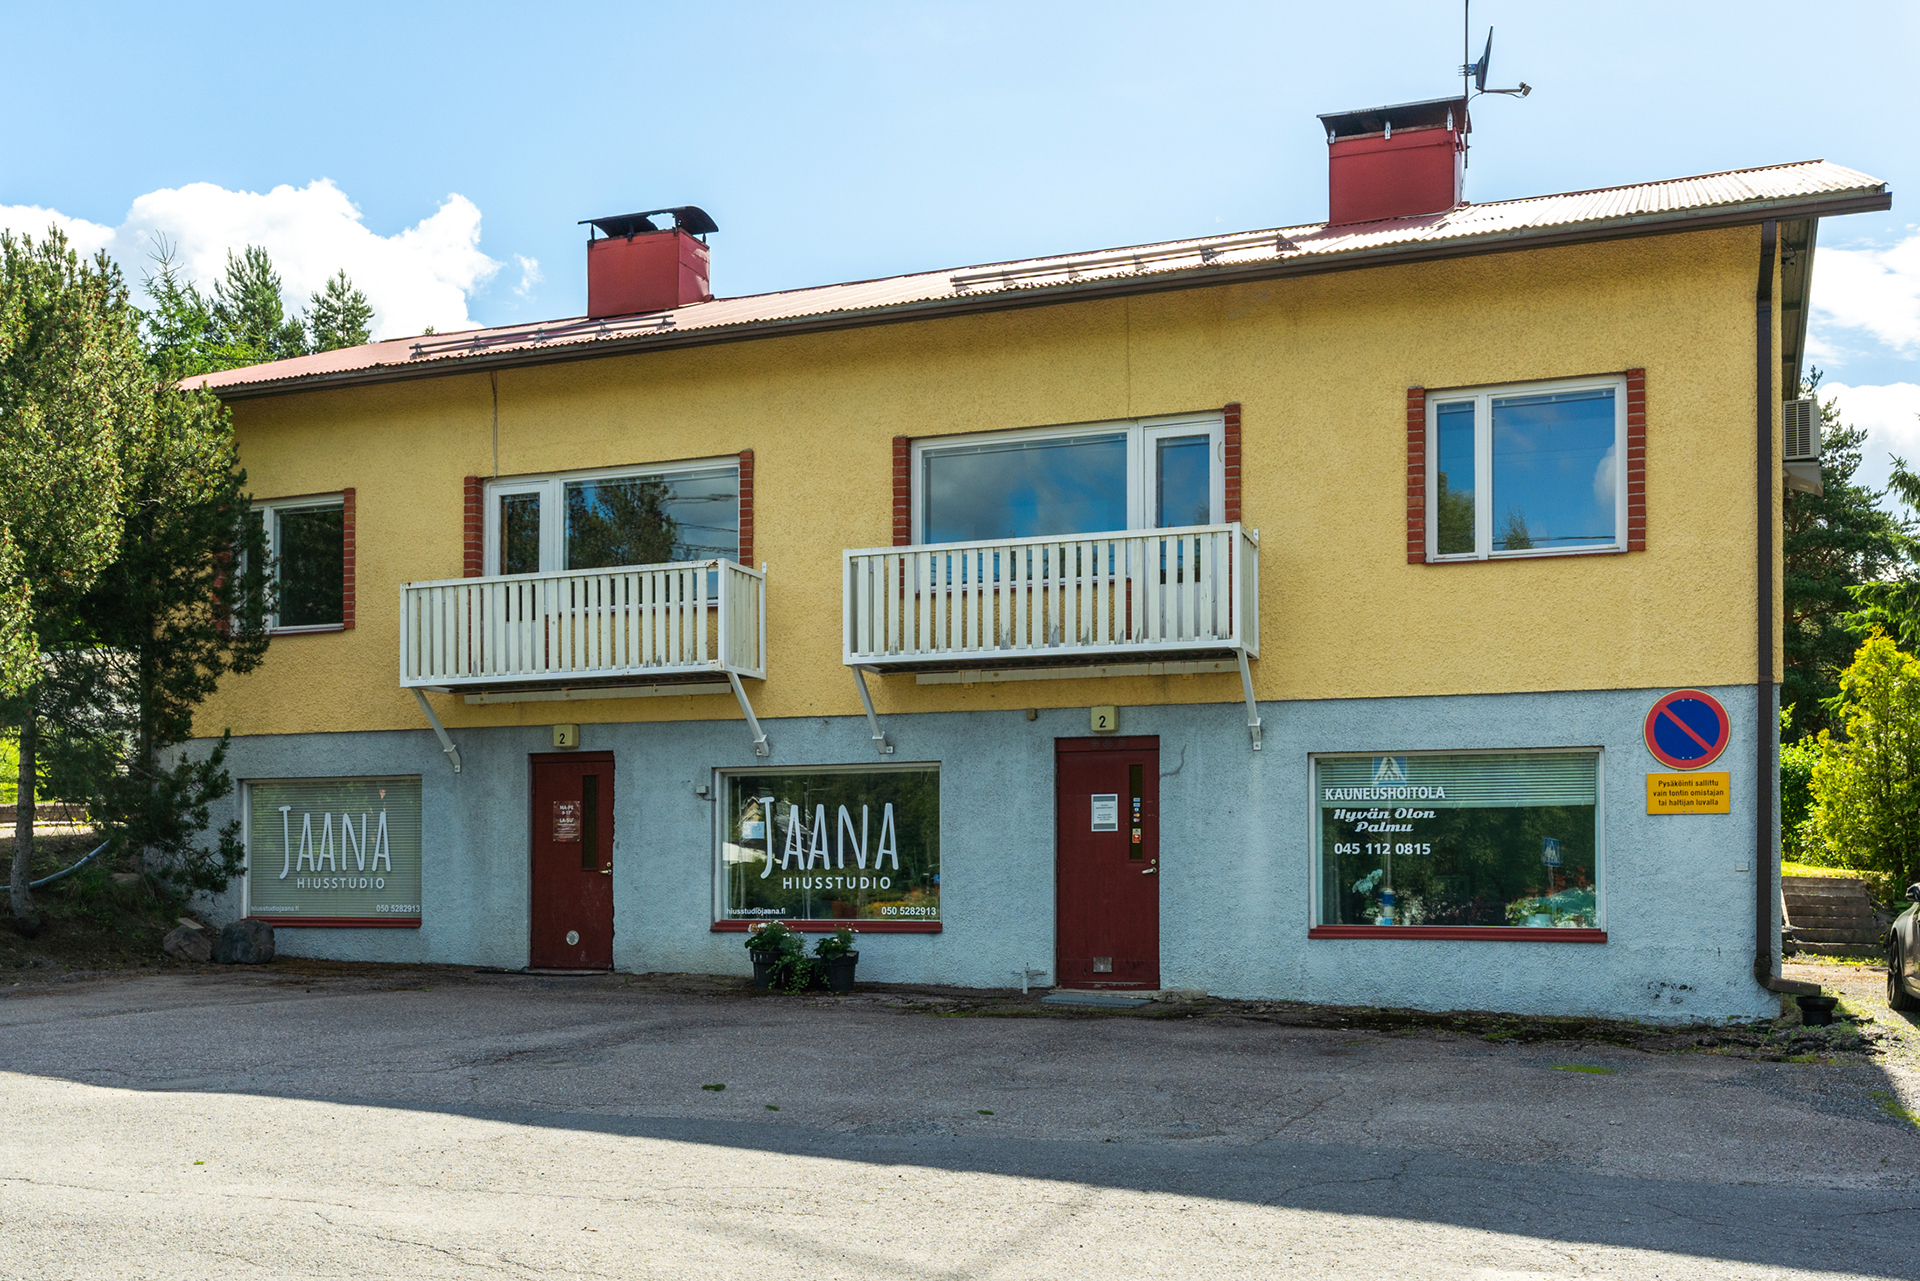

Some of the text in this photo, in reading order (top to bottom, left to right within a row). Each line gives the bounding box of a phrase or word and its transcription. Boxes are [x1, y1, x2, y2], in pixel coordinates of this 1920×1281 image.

[1099, 716, 1106, 728] 2
[559, 733, 565, 744] 2
[1658, 779, 1719, 788] Pysäköinti sallittu
[1325, 786, 1446, 800] KAUNEUSHOITOLA
[1653, 789, 1724, 797] vain tontin omistajan
[1669, 799, 1695, 807] haltijan
[1696, 798, 1719, 806] luvalla
[1333, 808, 1437, 822] Hyvän Olon
[1355, 821, 1414, 833] Palmu
[278, 806, 391, 880] JAANA
[759, 796, 899, 879] JAANA
[1334, 843, 1431, 855] 045 112 0815
[297, 878, 385, 889] HIUSSTUDIO
[782, 876, 891, 890] HIUSSTUDIO
[251, 905, 300, 913] hiusstudiojaana.fi
[376, 904, 421, 913] 050 5282913
[726, 907, 786, 916] hiusstudiojaana.fi
[881, 906, 937, 916] 050 5282913
